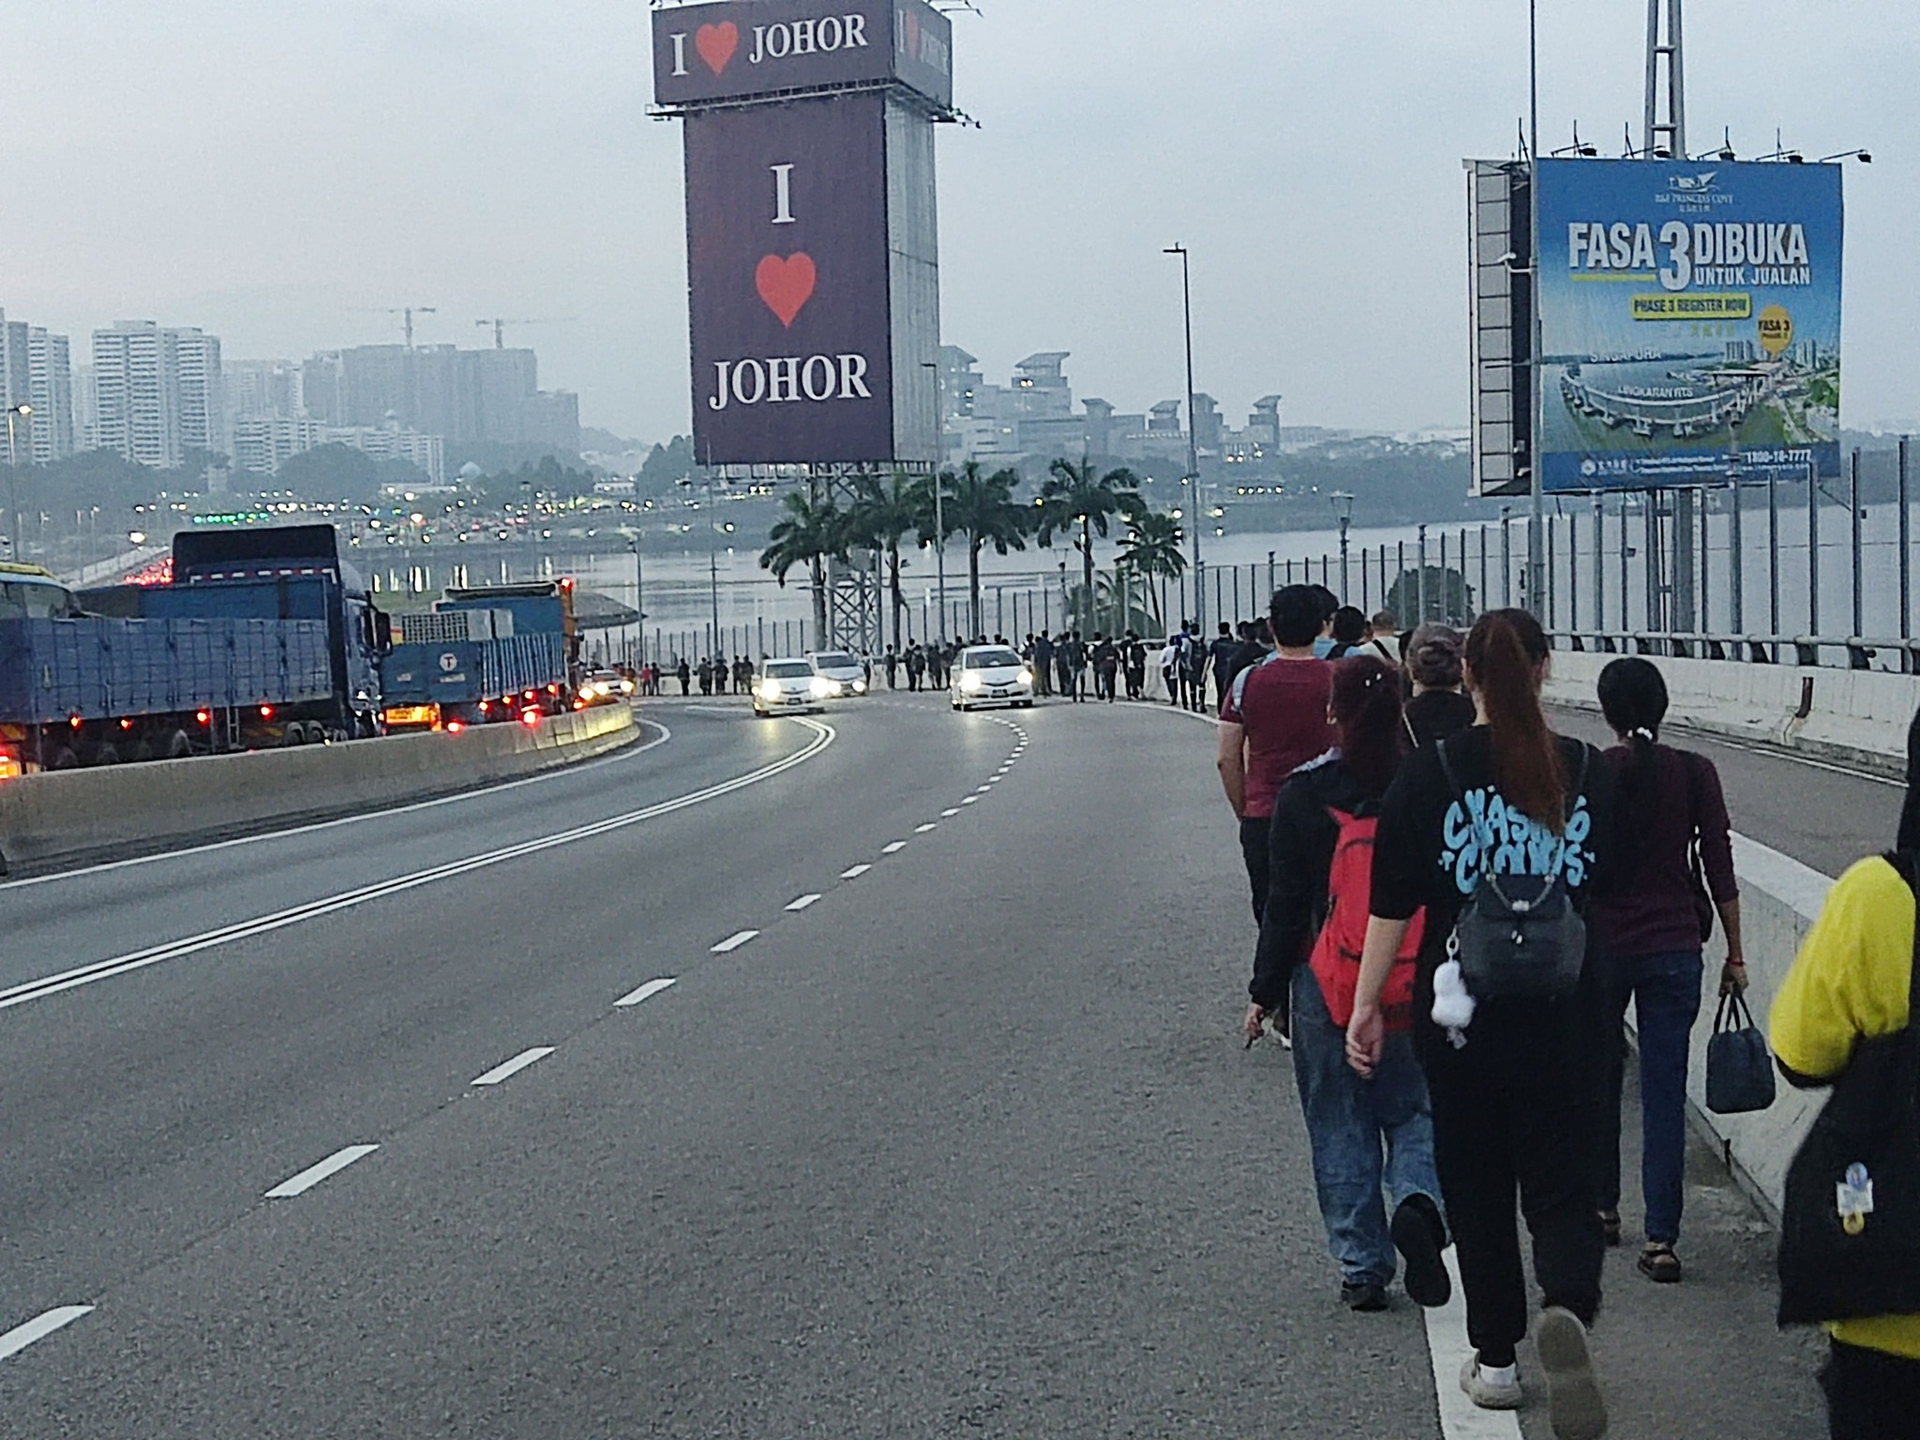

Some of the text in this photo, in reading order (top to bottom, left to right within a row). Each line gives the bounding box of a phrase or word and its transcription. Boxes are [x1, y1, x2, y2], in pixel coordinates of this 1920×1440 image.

[669, 32, 689, 77] I
[749, 13, 869, 64] JOHOR
[769, 163, 796, 224] I
[1568, 220, 1809, 291] FASA 3 DIBUKA
[1694, 266, 1810, 285] UNTUK JUALAN
[1634, 298, 1747, 312] PHASE 3 REGISTER NOW
[1758, 319, 1790, 331] FASA 3
[1590, 347, 1662, 363] SNGAPURA
[708, 353, 872, 410] JOHOR
[444, 656, 454, 669] T
